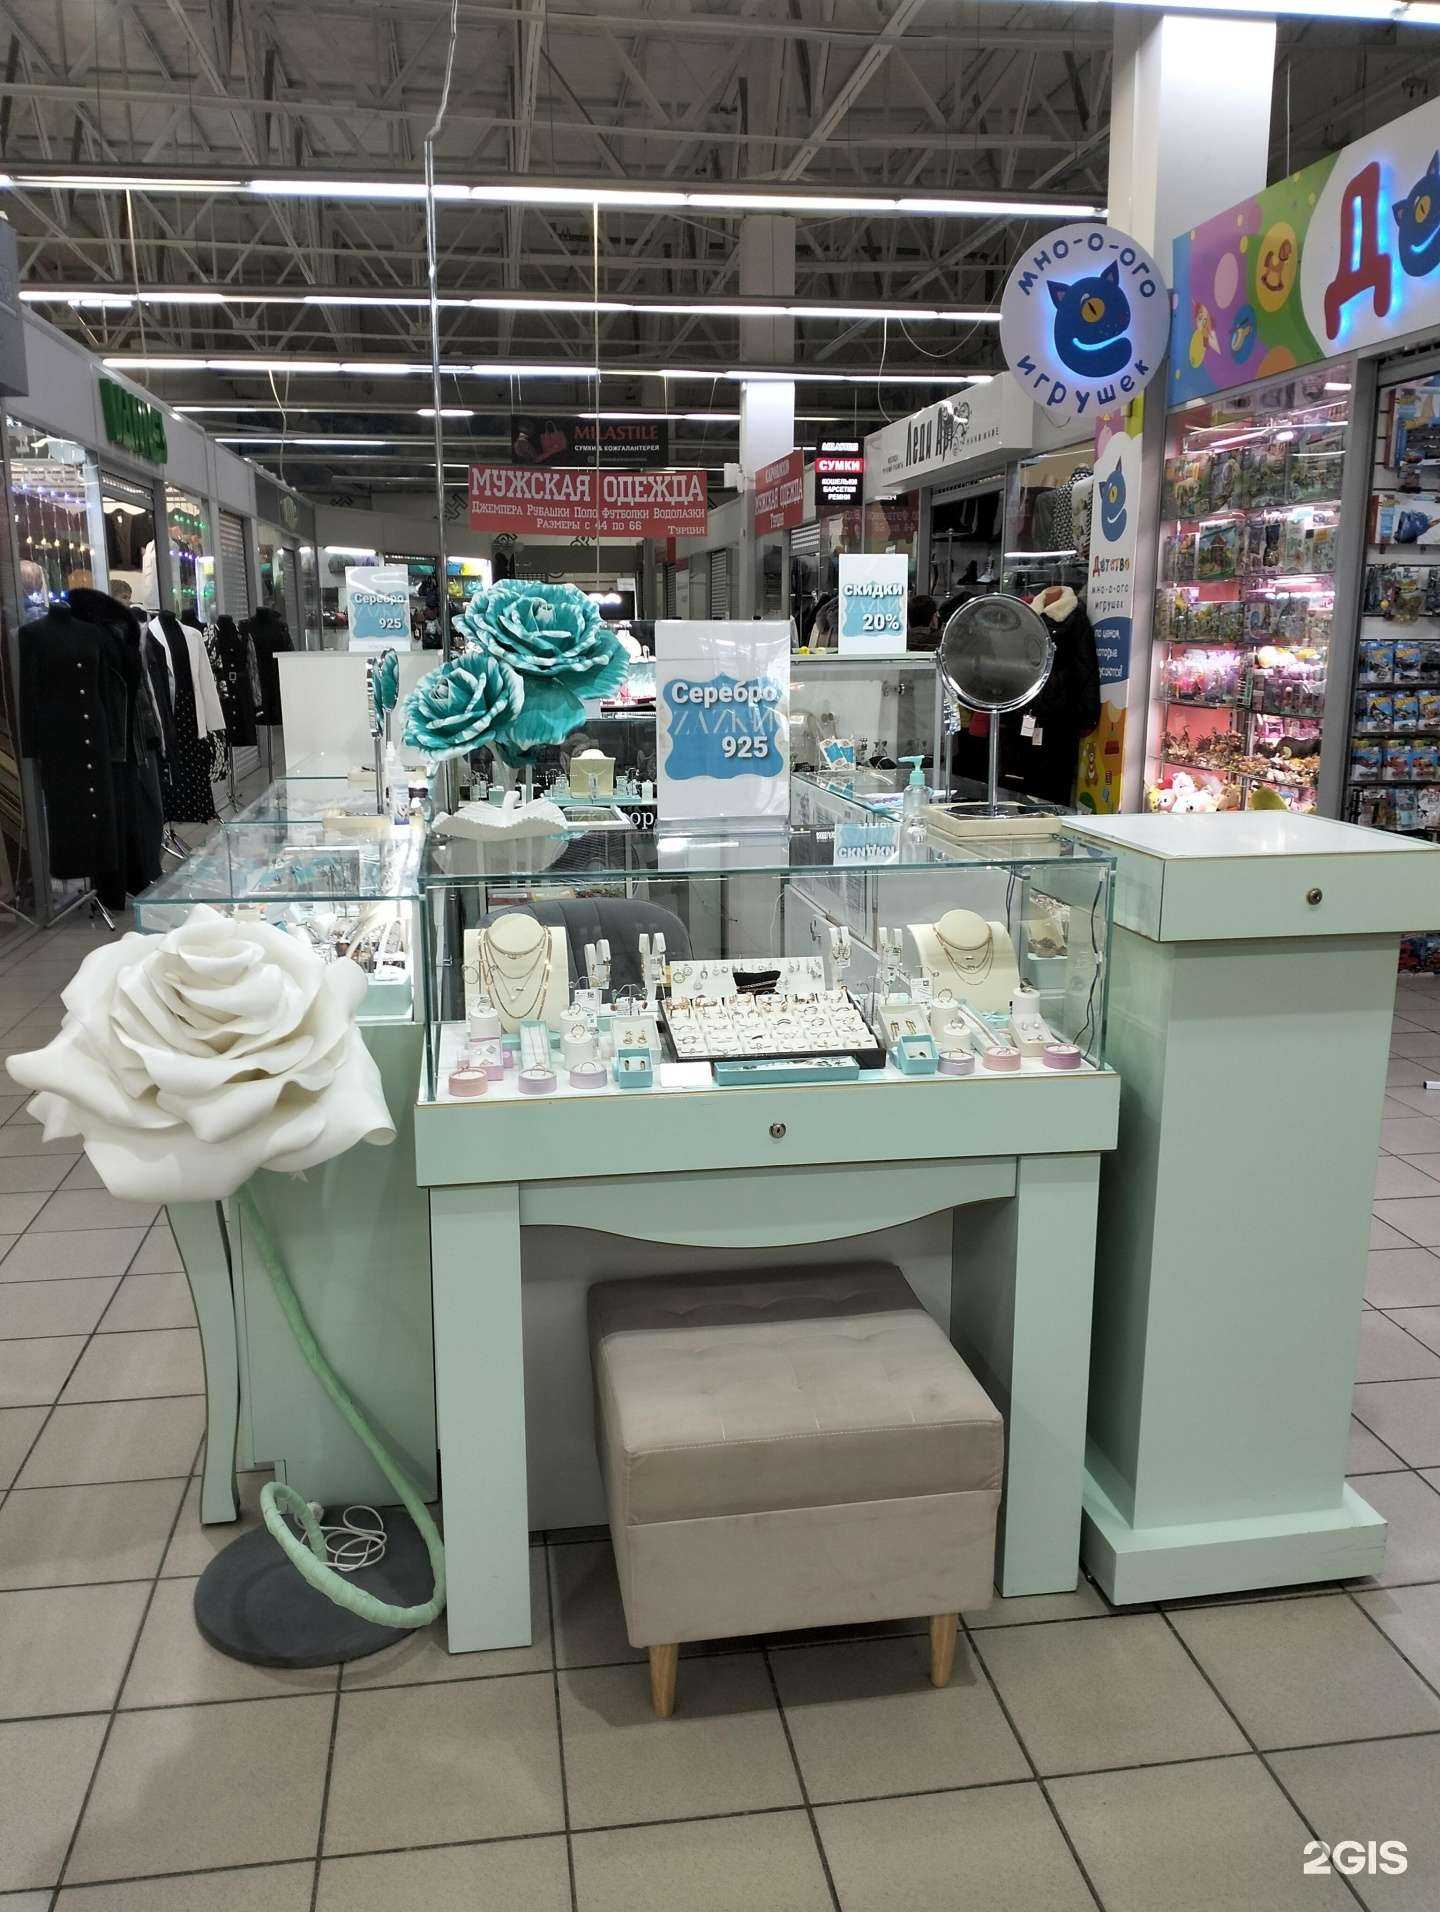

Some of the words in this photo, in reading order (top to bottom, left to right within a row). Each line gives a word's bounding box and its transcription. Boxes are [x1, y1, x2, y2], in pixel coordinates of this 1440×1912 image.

[818, 460, 860, 471] СУМКИ
[471, 467, 591, 502] МУЖСКАЯ
[603, 475, 704, 506] ОДЕЖДА
[629, 520, 642, 530] 66
[380, 617, 402, 629] 925
[862, 613, 900, 632] 20%
[671, 680, 778, 709] Серебро
[721, 735, 769, 758] 925
